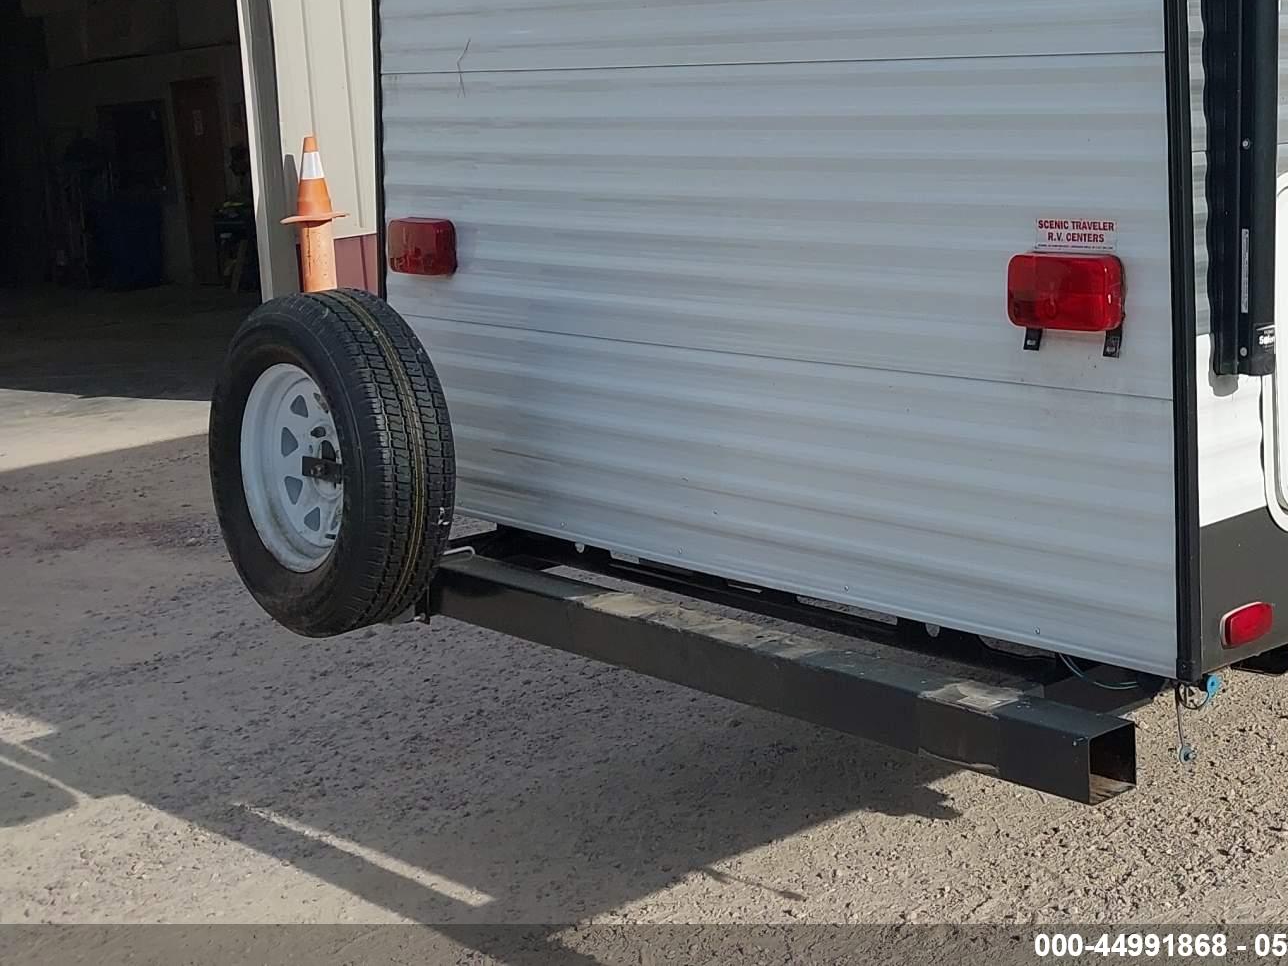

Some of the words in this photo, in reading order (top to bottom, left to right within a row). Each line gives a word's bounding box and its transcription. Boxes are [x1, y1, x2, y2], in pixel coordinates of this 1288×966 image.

[1038, 219, 1069, 230] SCENIC
[1071, 220, 1115, 232] TRAVELER
[1047, 232, 1064, 242] R.V.
[1066, 232, 1105, 243] CENTERS
